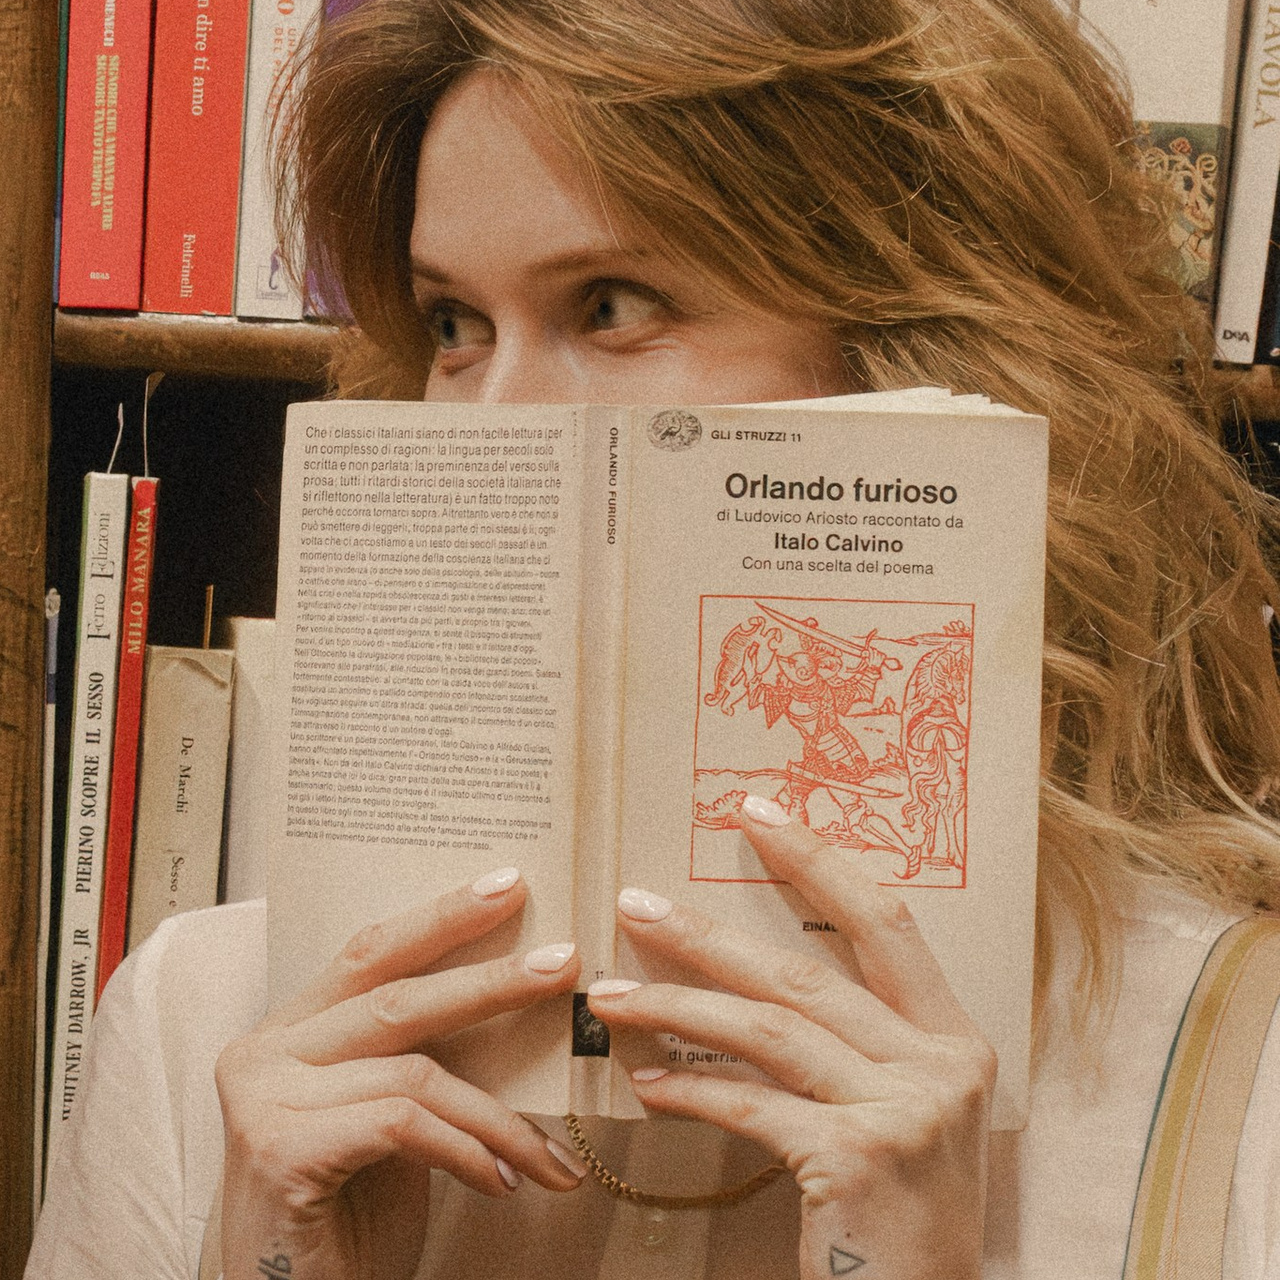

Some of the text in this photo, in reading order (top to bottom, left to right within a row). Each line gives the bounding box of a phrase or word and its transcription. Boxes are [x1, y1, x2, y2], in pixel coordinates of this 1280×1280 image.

[193, 13, 212, 51] dire
[193, 56, 210, 71] ti
[190, 76, 205, 116] amo
[179, 233, 195, 298] Feltrinelli
[306, 426, 542, 439] Che classici italiani siano non facile lettura
[710, 430, 801, 442] GLI STRUZZI 11
[606, 427, 617, 544] ORLANDO FURIOSO
[725, 472, 957, 504] Orlando furioso
[716, 508, 964, 528] di Ludovico Ariosto raccontato da
[773, 531, 903, 553] Italo Calvino
[86, 512, 117, 639] Ferro Edizioni
[126, 506, 153, 654] MILO MANARA
[741, 556, 933, 576] Con una scelta del poema
[75, 672, 104, 893] PIERINO SCOPRE IL SESSO
[174, 737, 193, 813] De Marchi
[168, 856, 184, 907] Sesso e
